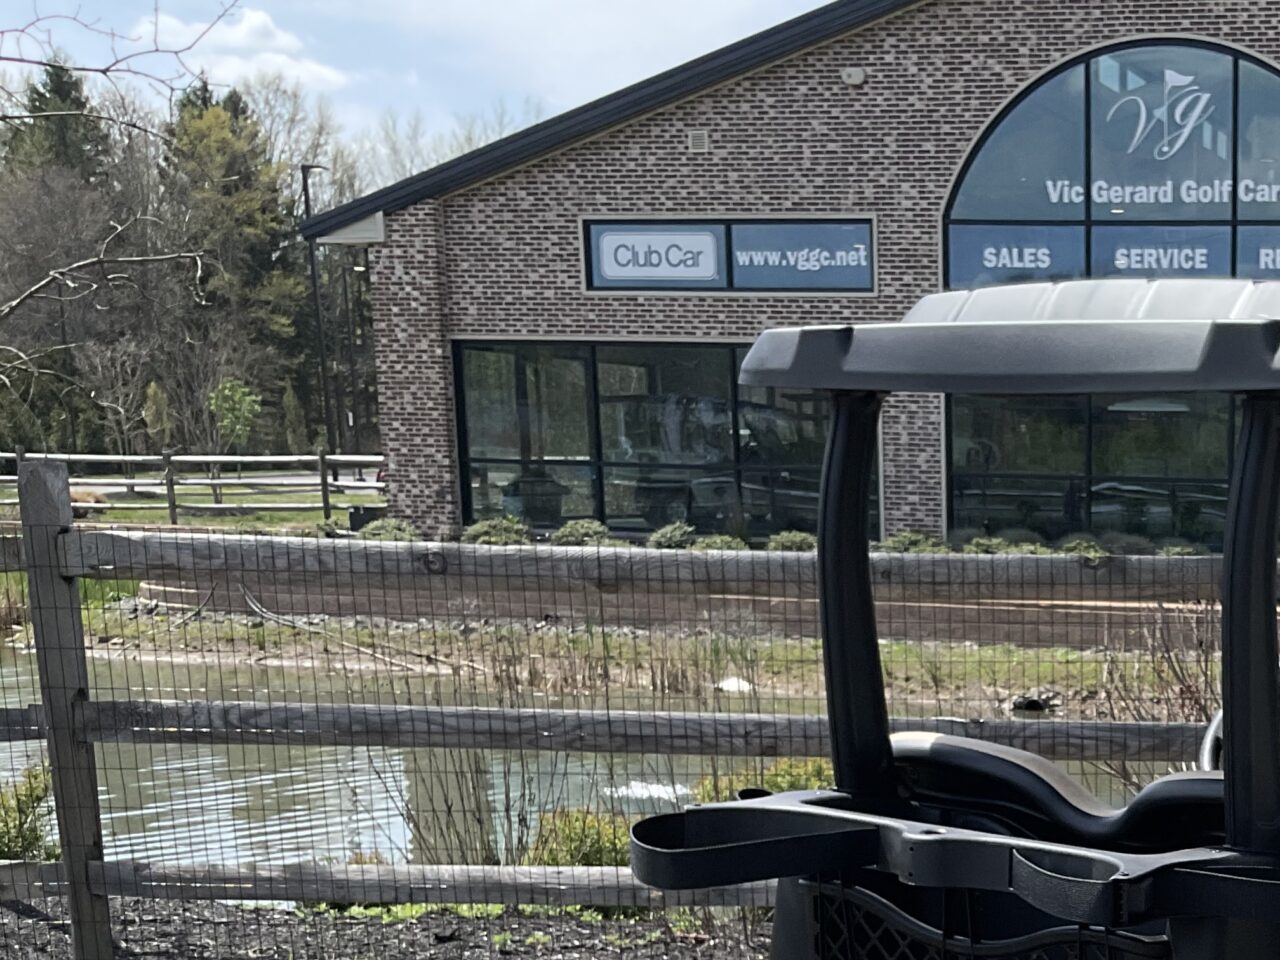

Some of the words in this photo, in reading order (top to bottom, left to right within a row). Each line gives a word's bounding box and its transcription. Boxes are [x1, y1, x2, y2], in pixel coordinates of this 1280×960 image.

[1045, 180, 1085, 203] Vic
[1091, 180, 1174, 204] Gerard
[1179, 179, 1233, 203] Golf
[612, 243, 663, 268] Club
[664, 243, 704, 268] Car
[736, 247, 868, 271] www.vggc.net
[982, 246, 1051, 269] SALES
[1114, 247, 1209, 270] SERVICE
